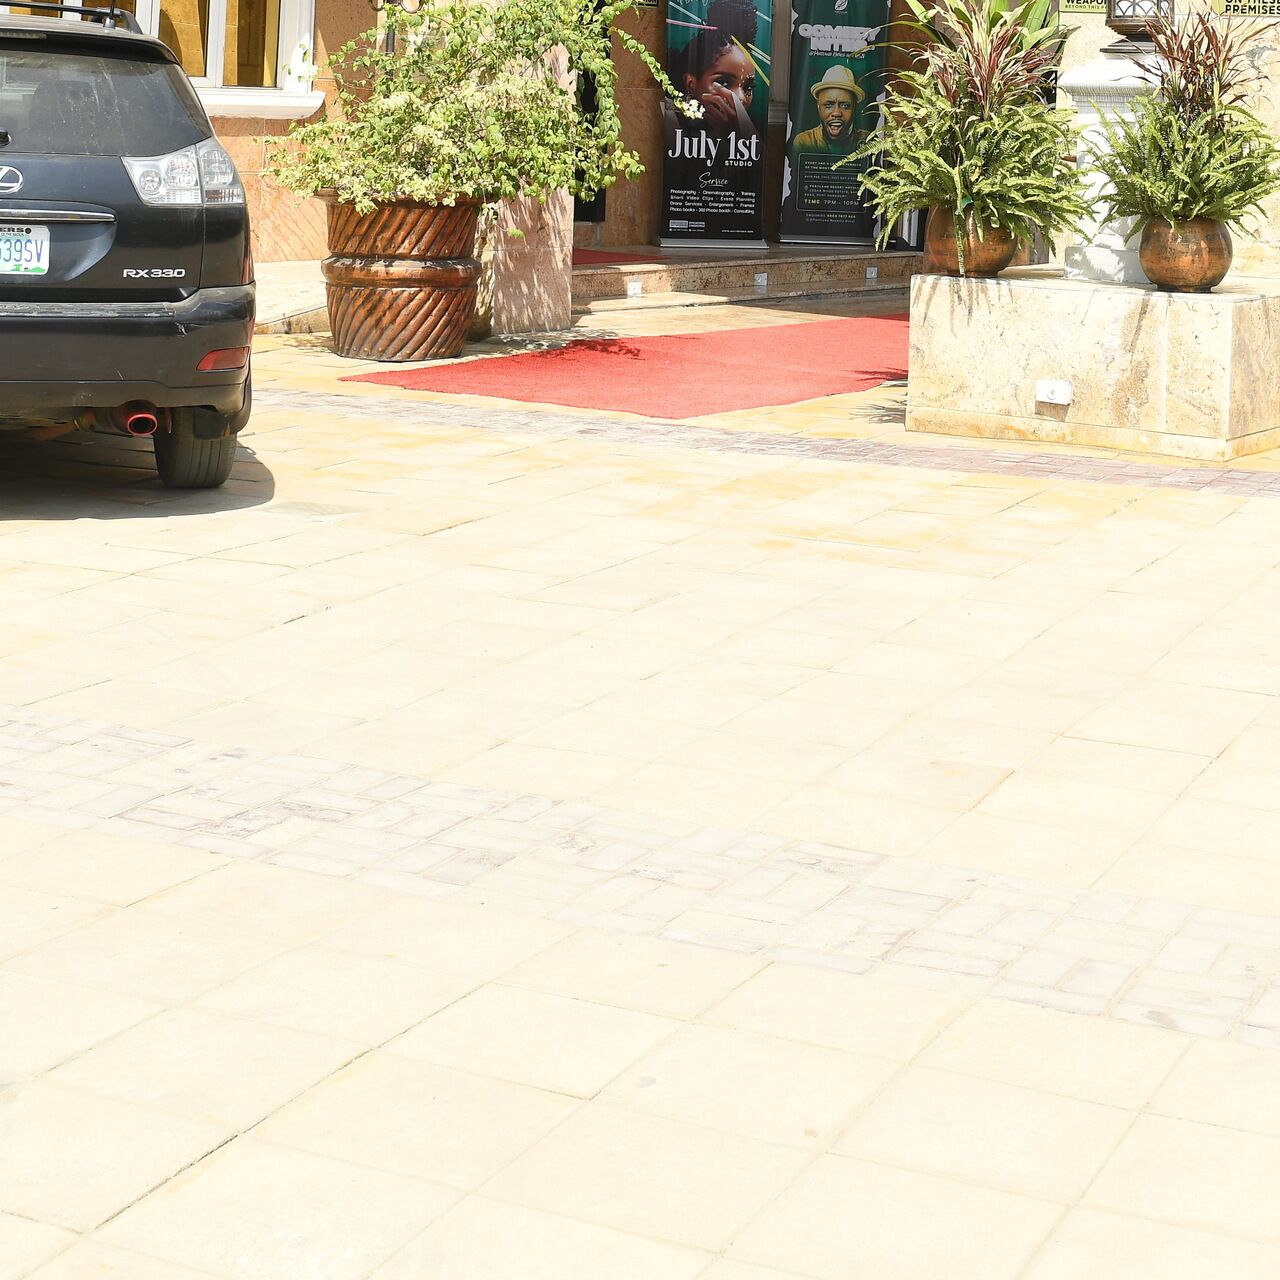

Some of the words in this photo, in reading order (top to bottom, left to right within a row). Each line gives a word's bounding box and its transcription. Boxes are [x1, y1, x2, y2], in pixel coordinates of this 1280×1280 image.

[668, 128, 722, 167] July
[727, 131, 761, 161] 1st
[698, 171, 729, 188] Service
